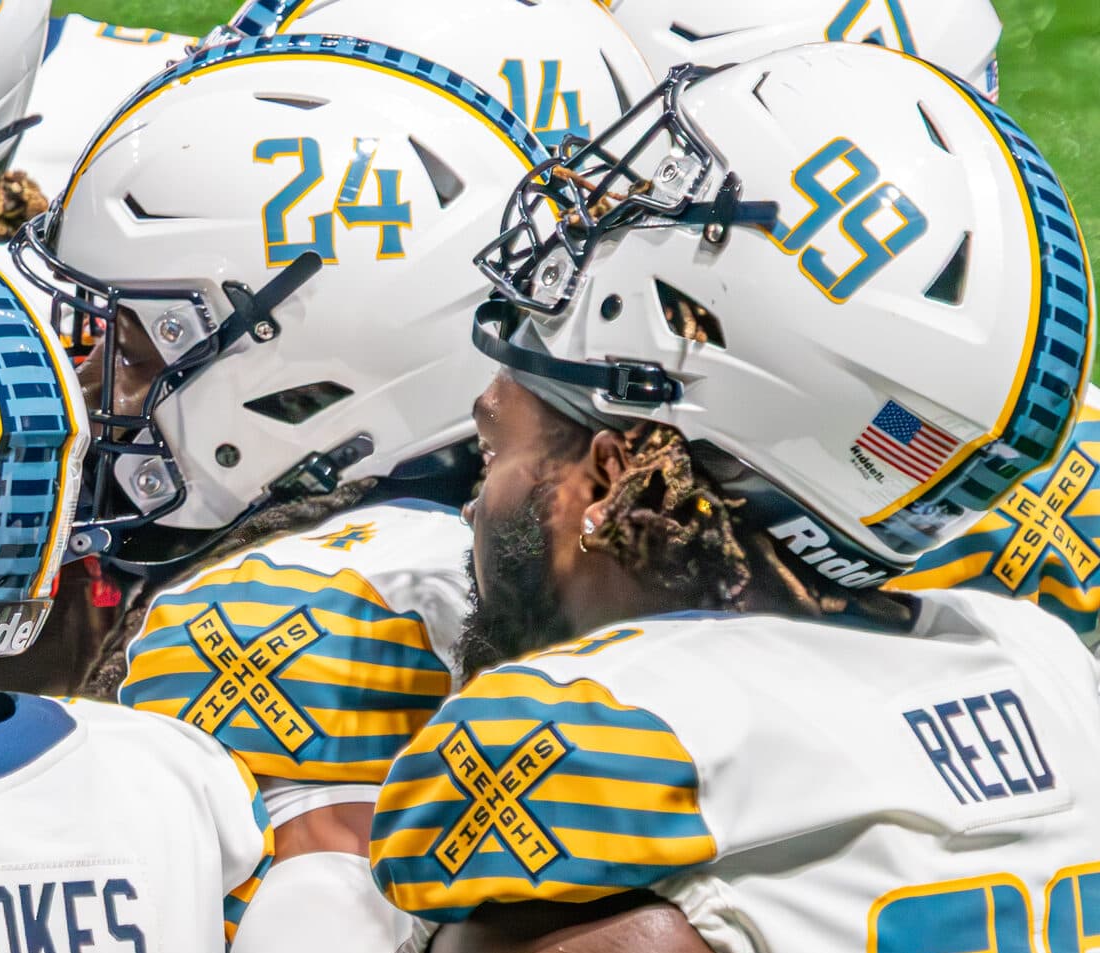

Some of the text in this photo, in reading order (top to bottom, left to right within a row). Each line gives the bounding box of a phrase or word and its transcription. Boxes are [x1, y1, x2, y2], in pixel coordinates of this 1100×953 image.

[253, 137, 412, 269] 24
[758, 136, 928, 304] 99
[767, 516, 887, 589] Ridd
[1001, 460, 1086, 582] FISHERS
[1005, 484, 1091, 568] EIGHT
[192, 623, 308, 732] FISHERS
[197, 618, 303, 738] FREIGHT
[444, 739, 554, 865] FISHERS
[450, 740, 548, 859] FREIGHT
[903, 689, 1056, 805] REED
